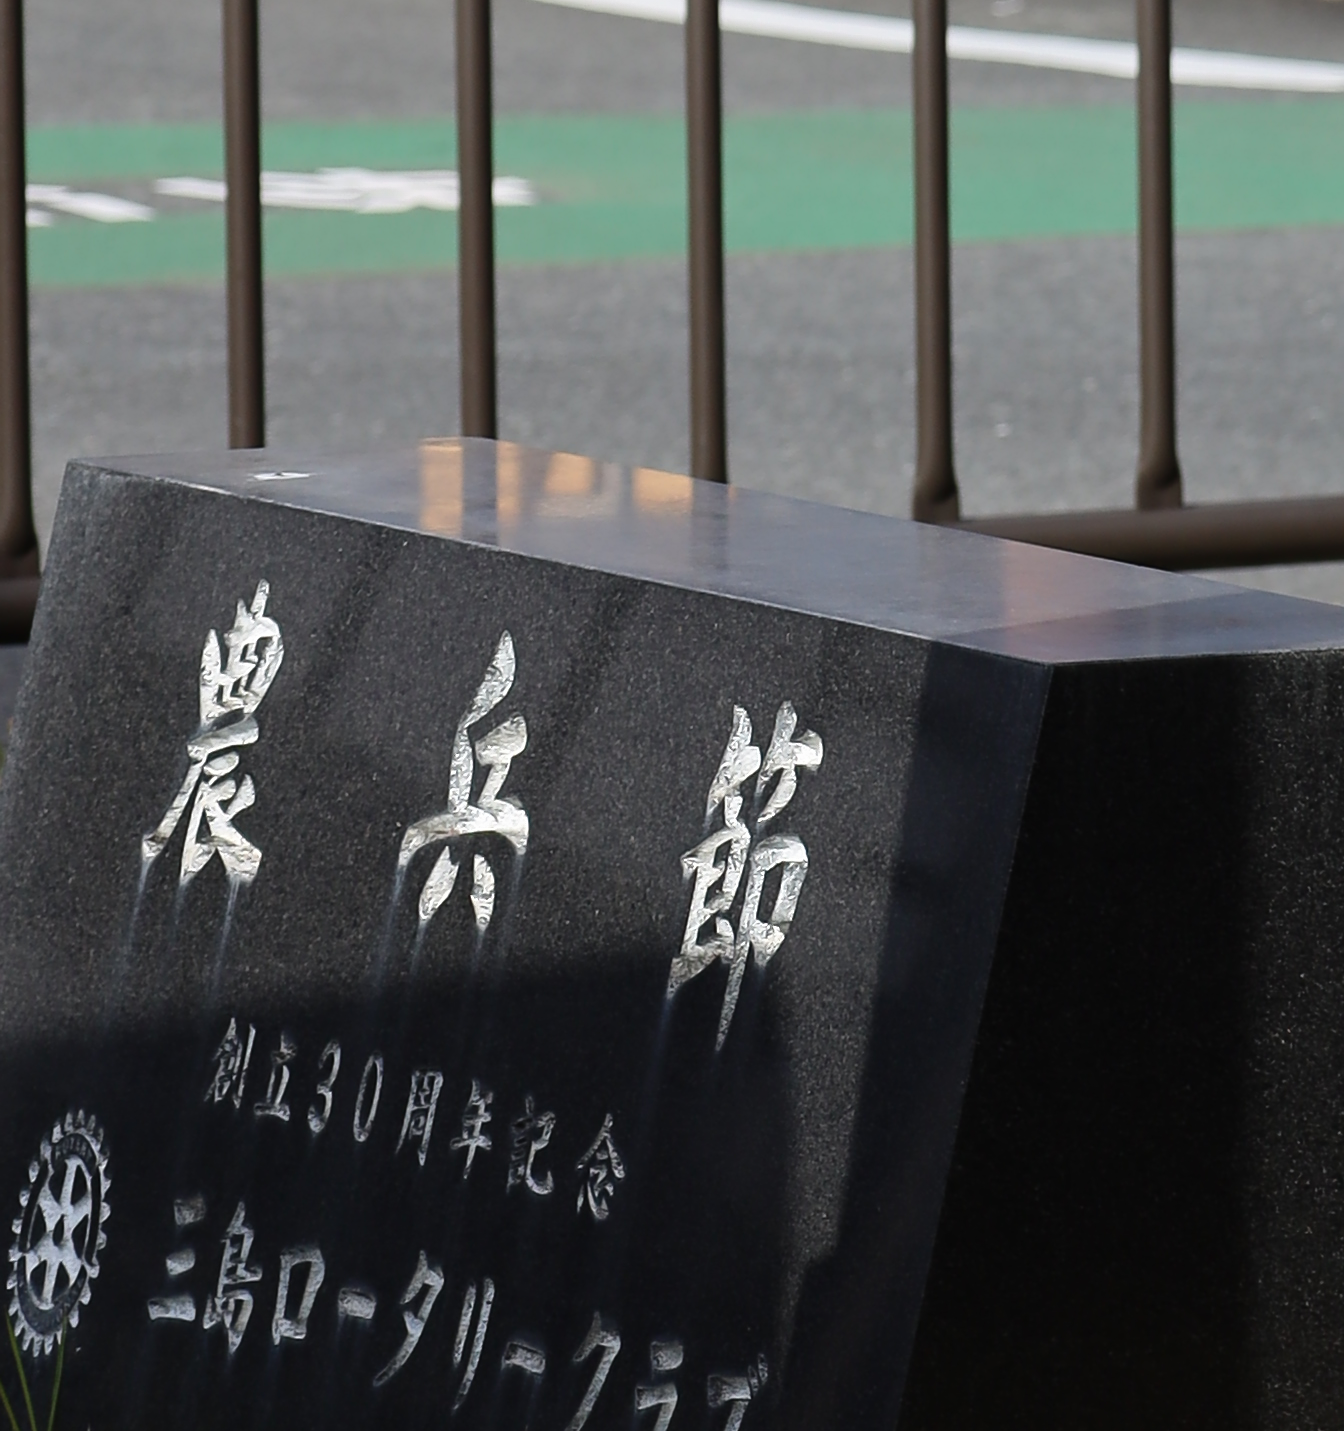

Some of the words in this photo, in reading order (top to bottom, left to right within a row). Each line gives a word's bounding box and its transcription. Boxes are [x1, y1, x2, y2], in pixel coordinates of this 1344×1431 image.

[142, 579, 823, 1052] 農兵節
[204, 1017, 626, 1219] 創立30周年記念
